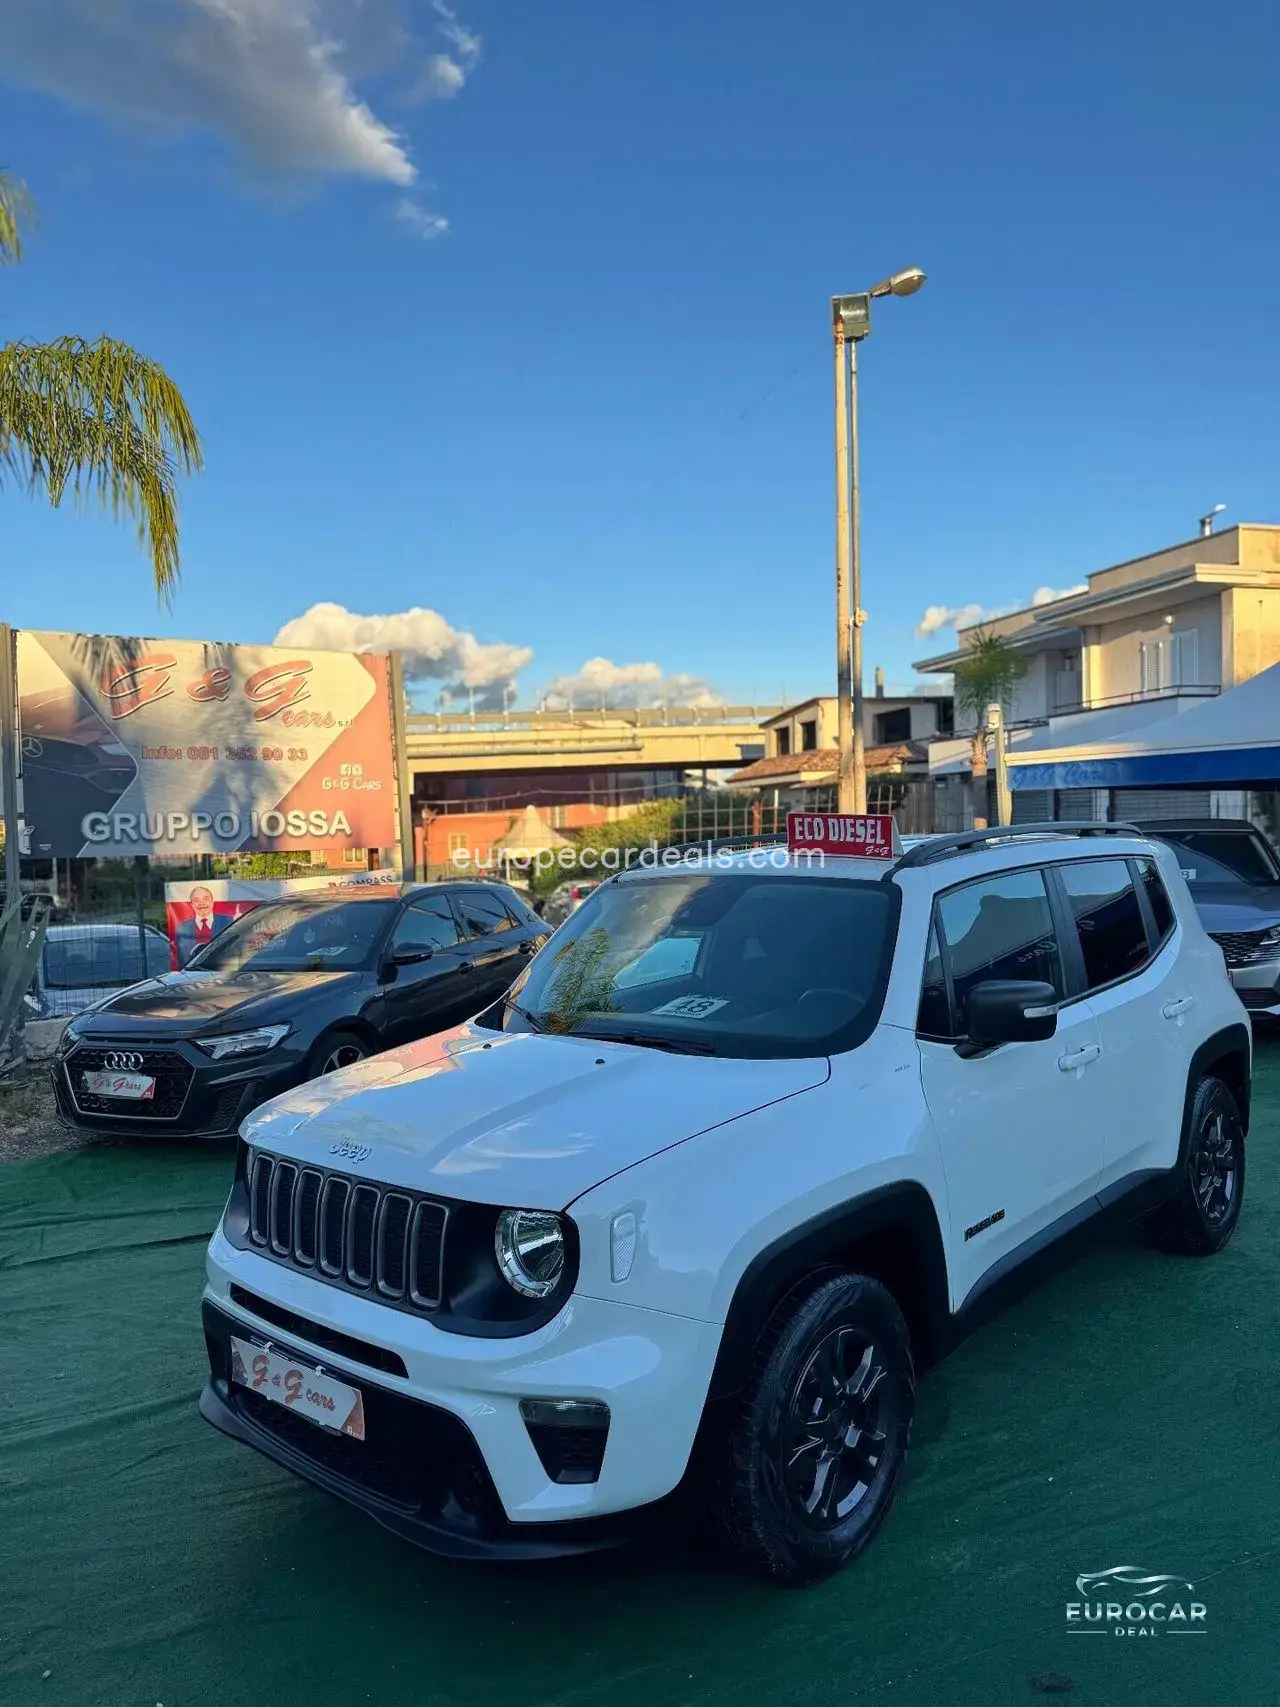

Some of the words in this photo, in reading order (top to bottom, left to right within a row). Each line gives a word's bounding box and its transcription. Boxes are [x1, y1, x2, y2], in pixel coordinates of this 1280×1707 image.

[142, 745, 182, 760] Info:
[81, 810, 240, 843] GRUPPO
[250, 809, 352, 838] IOSSA
[795, 817, 825, 840] ECO
[828, 819, 885, 844] DIESEL
[328, 1135, 373, 1165] Jeep
